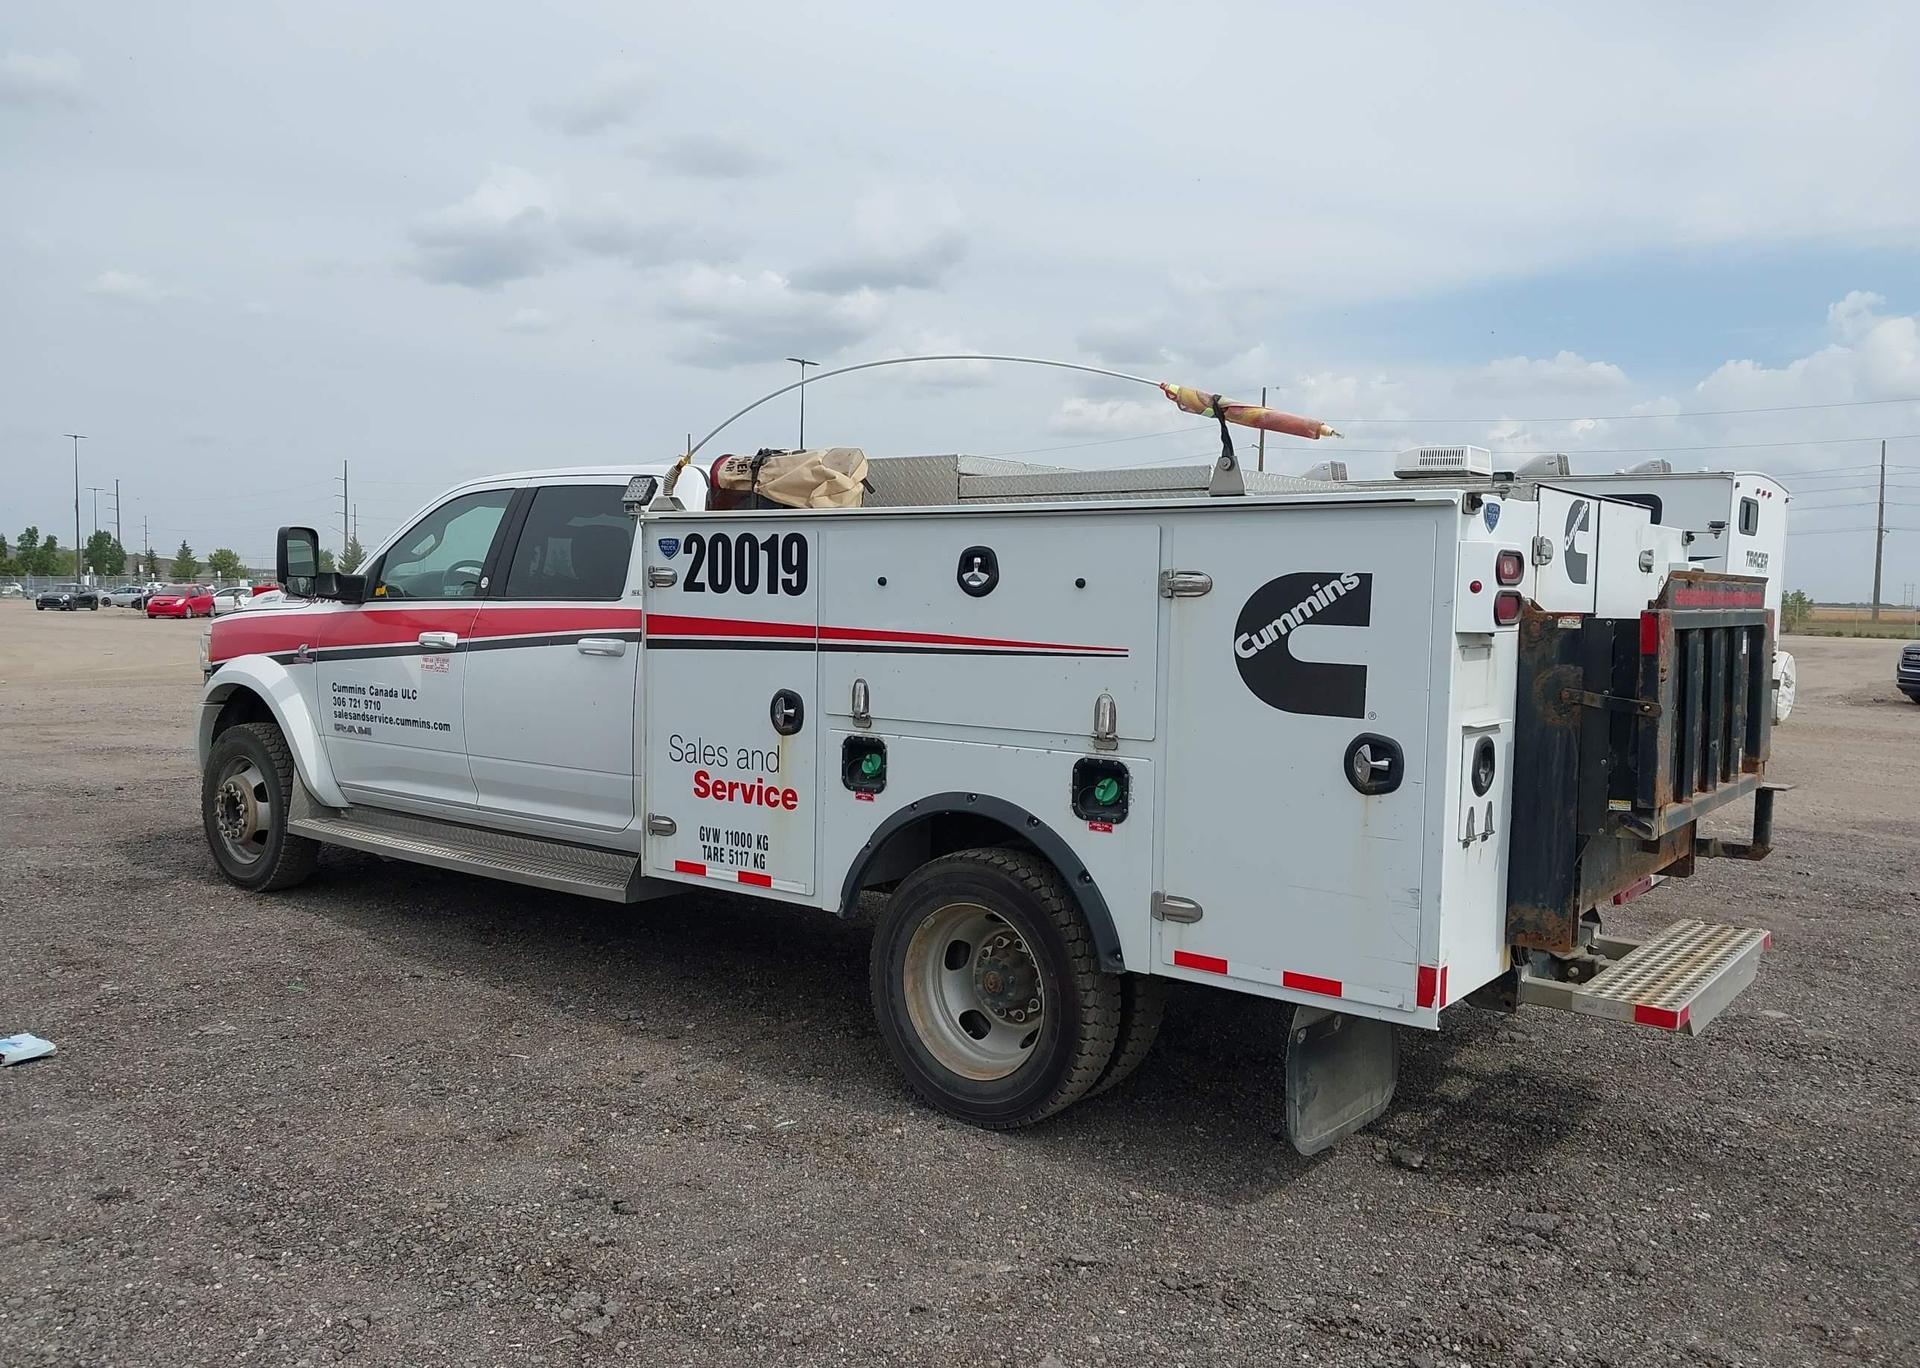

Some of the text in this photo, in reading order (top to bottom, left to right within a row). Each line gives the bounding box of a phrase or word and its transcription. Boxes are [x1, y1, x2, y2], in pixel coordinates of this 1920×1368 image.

[683, 532, 808, 596] 20019
[1234, 572, 1360, 659] Cummins
[331, 682, 418, 700] Cummins Canada ULC
[332, 696, 381, 711] 306 721 9710
[334, 709, 451, 732] salesandservice.cummins.com
[669, 734, 780, 773] Sales and
[693, 769, 798, 811] Service
[699, 825, 769, 852] GVW 11000 KG
[702, 844, 766, 870] TARE 5117 KG
